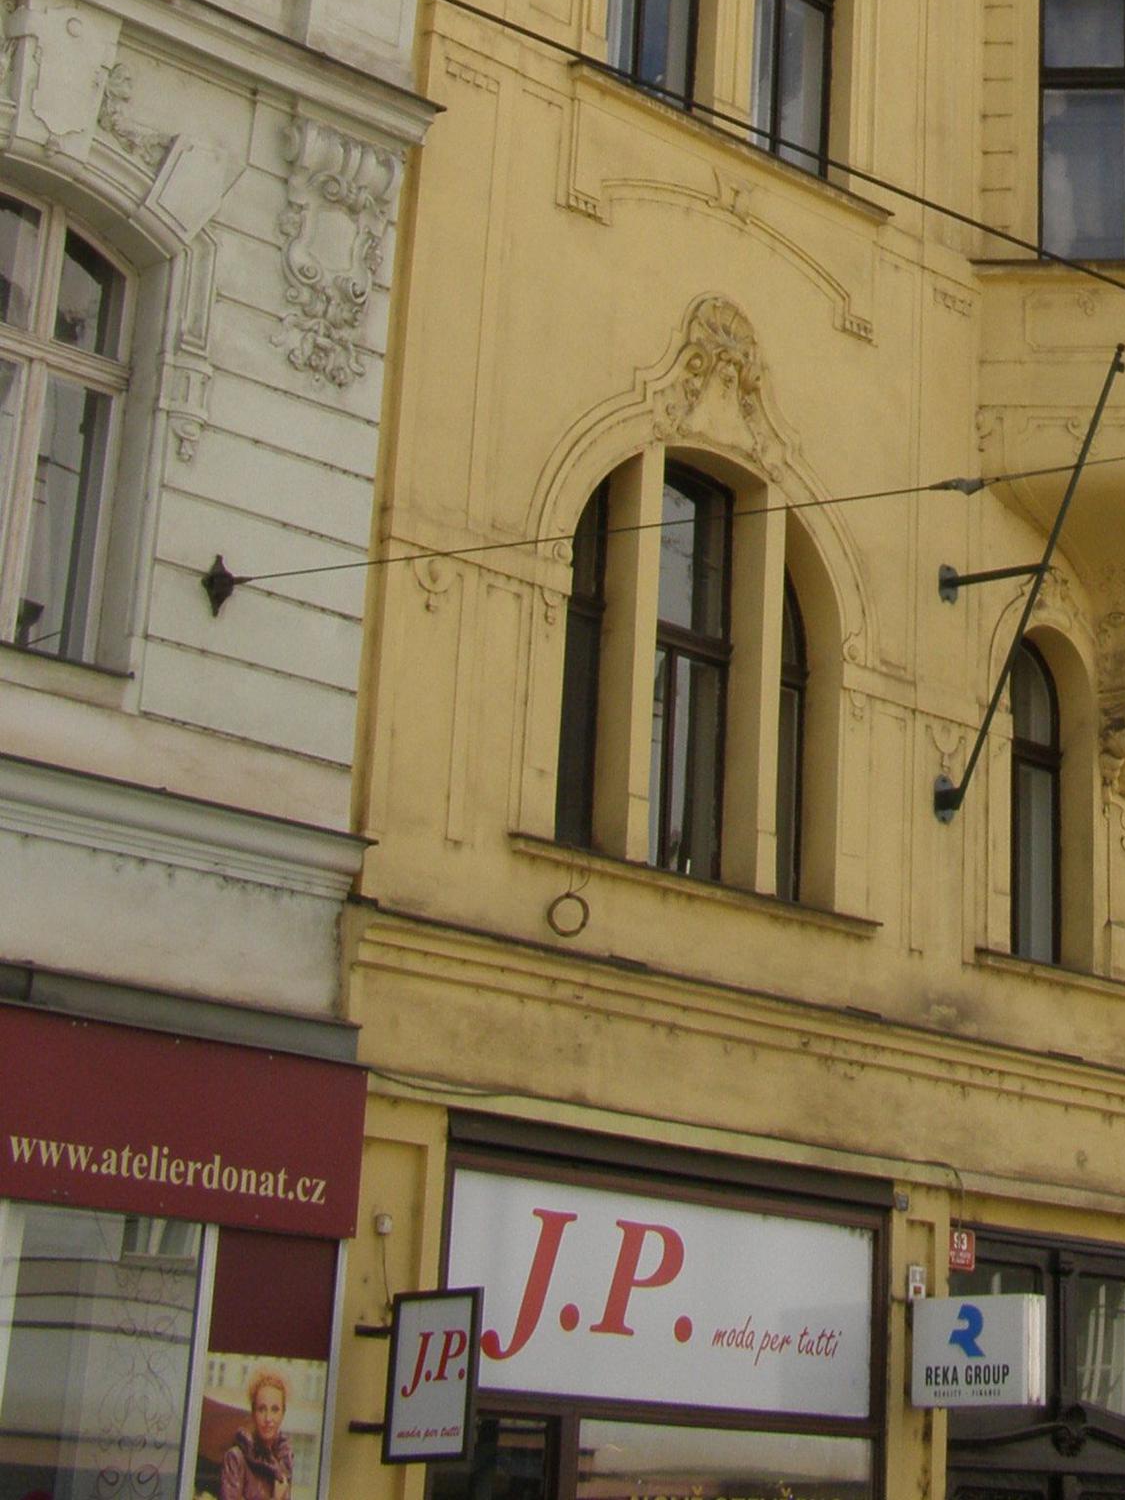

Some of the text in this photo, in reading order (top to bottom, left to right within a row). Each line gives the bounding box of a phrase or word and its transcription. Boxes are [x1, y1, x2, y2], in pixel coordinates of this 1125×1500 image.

[9, 1135, 327, 1204] www.atelierdonat.cz
[480, 1208, 694, 1361] J.P.
[401, 1328, 467, 1398] J.P.
[711, 1315, 843, 1366] moda per tutti
[925, 1364, 1009, 1386] REKA GROUP
